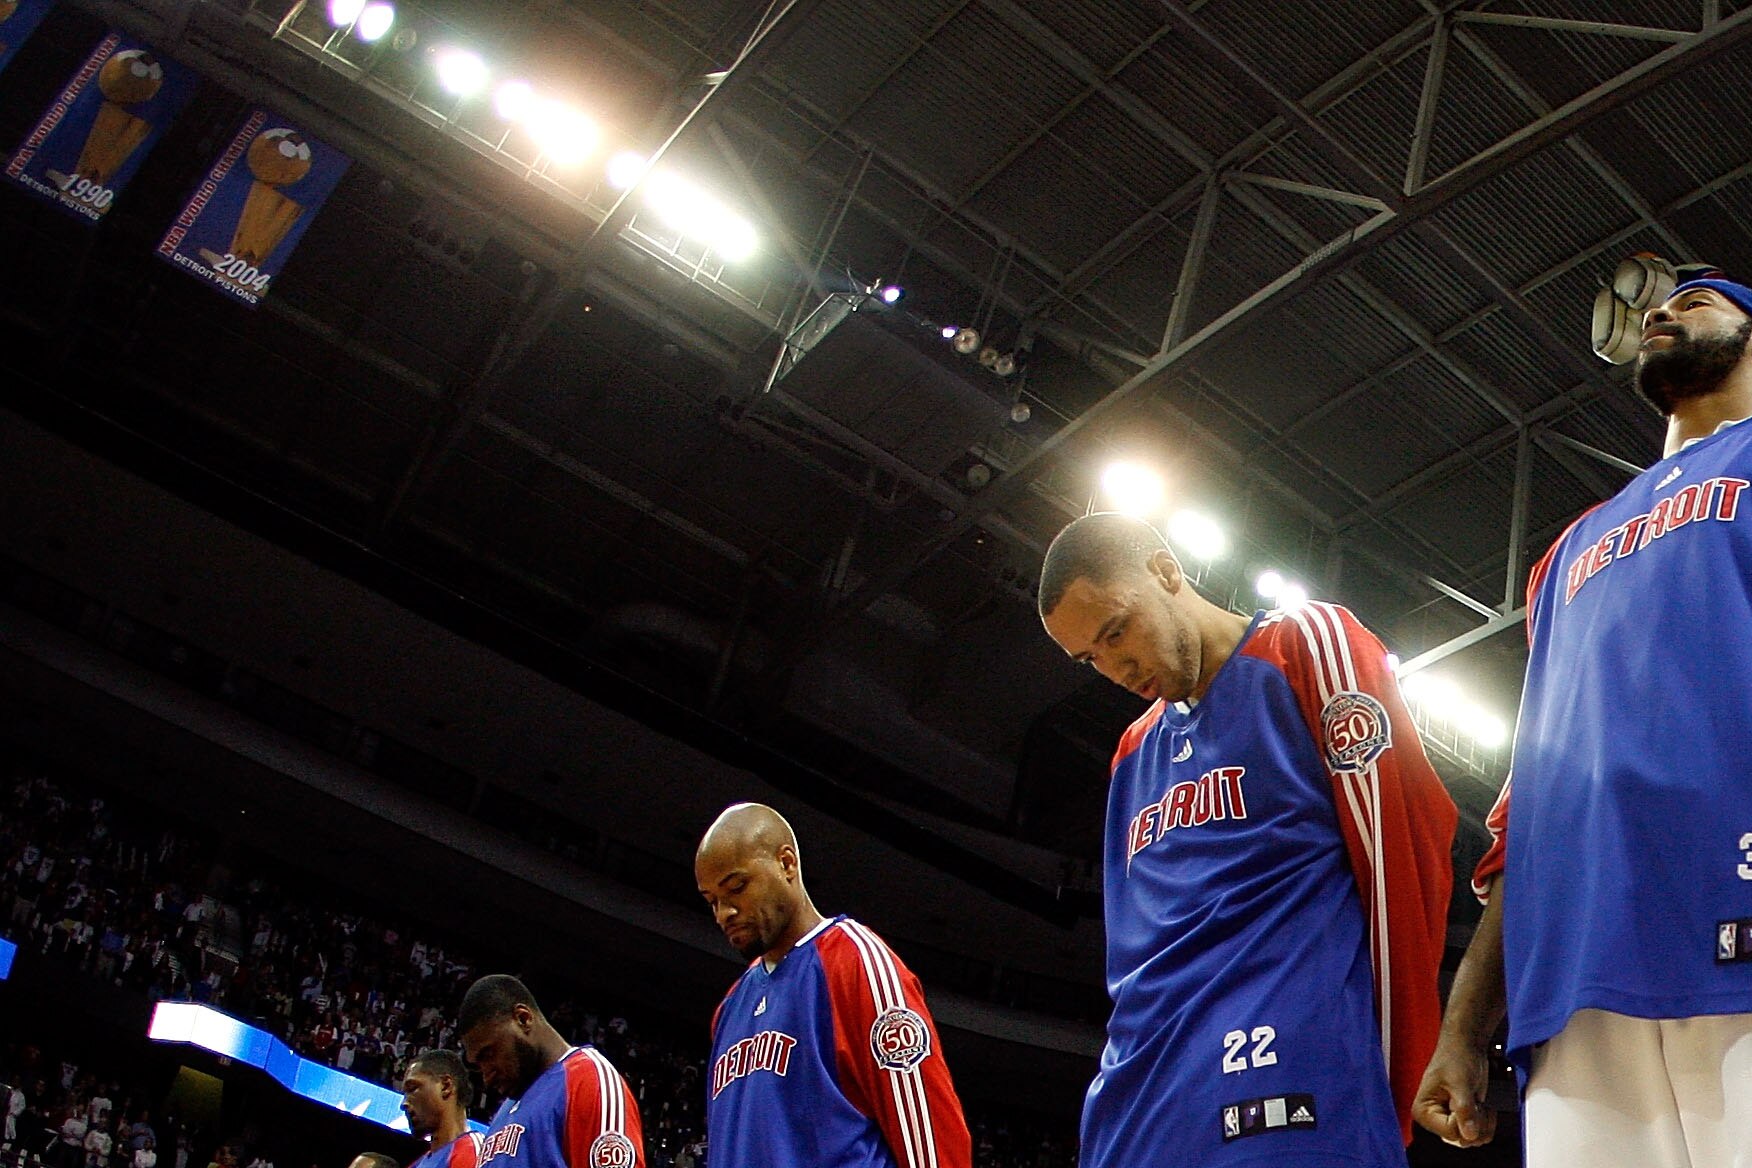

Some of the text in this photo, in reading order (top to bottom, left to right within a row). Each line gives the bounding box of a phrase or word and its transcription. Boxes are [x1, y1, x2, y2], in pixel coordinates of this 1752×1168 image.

[7, 34, 121, 178] NBA WORLD CHAMPIONS
[20, 174, 101, 220] DETROIT PISTONS
[61, 173, 114, 208] 1990
[159, 111, 267, 257] NBA WORLD CHAMPIONS
[173, 252, 259, 304] DETROIT PISTONS
[213, 253, 271, 292] 2004
[1566, 477, 1750, 605] DETROIT
[1333, 713, 1370, 752] 50
[885, 1025, 915, 1053] 50
[1222, 1025, 1278, 1074] 22
[601, 1147, 623, 1166] 50
